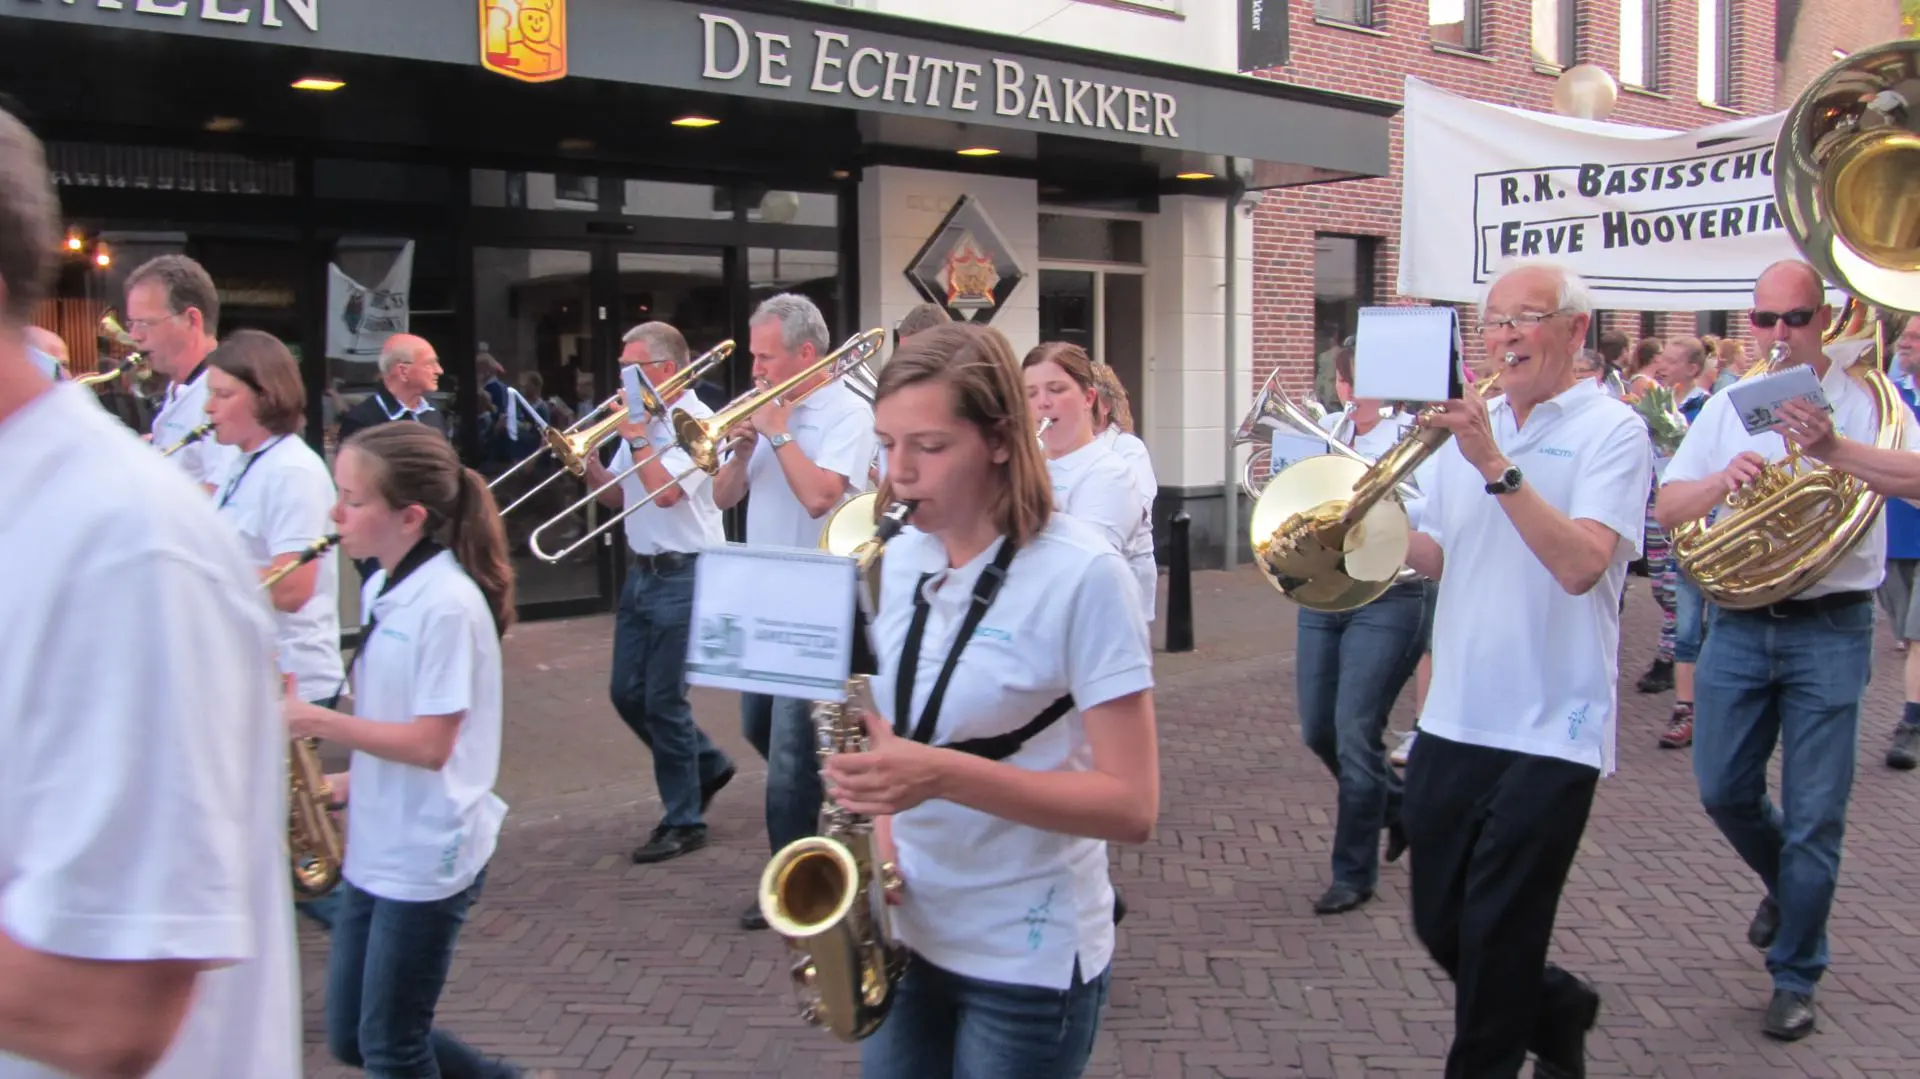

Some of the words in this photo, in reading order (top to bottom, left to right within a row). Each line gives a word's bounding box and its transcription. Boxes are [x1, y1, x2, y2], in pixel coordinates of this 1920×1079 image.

[699, 13, 793, 88] DE
[810, 30, 982, 111] ECHTE
[992, 58, 1179, 137] BAKKER
[1500, 173, 1566, 206] R.K.
[1500, 221, 1584, 257] ERVE
